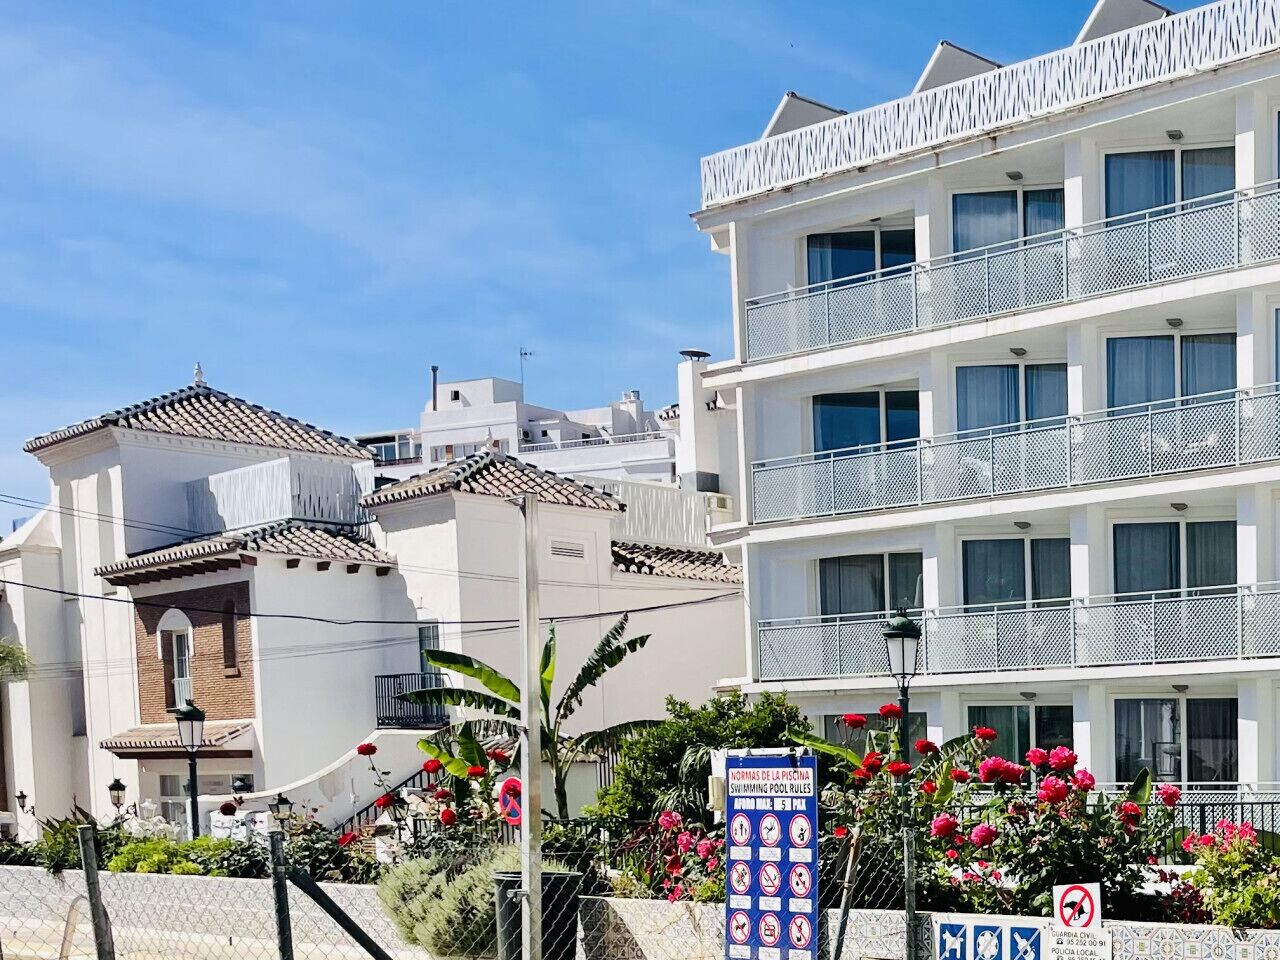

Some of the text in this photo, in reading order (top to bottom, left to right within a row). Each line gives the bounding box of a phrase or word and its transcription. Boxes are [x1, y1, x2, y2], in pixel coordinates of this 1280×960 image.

[731, 771, 810, 781] NORMAS DE LA PISCINA
[730, 784, 811, 794] SWIMMING POOL RULES
